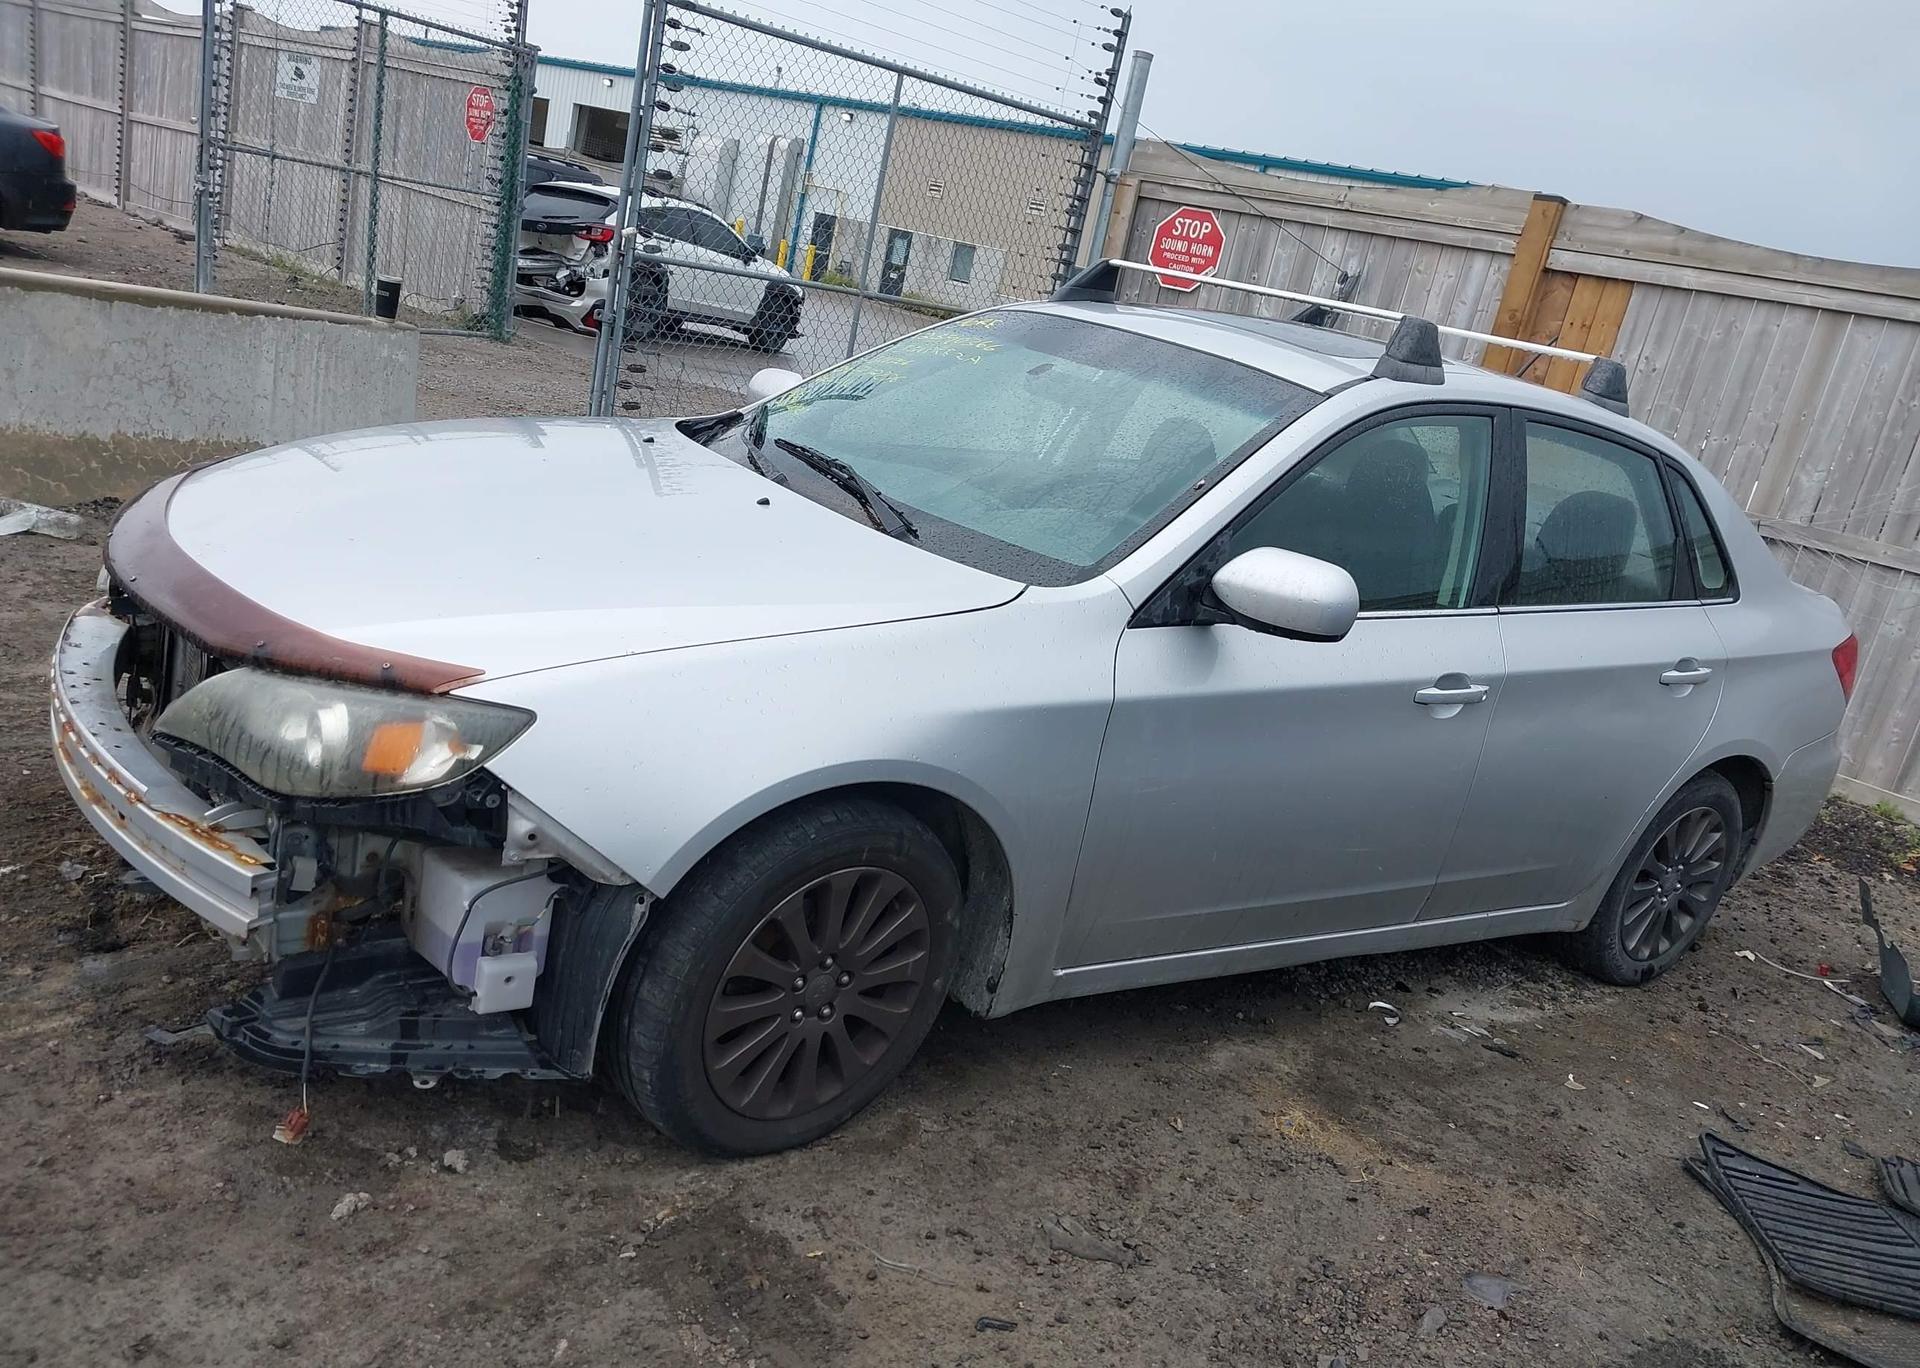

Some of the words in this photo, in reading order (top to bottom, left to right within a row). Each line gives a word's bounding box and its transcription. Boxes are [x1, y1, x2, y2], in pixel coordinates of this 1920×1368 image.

[472, 93, 490, 108] STOP
[1172, 218, 1212, 239] STOP
[1160, 237, 1188, 252] SOUND
[1190, 243, 1214, 257] HORN
[1162, 251, 1189, 262] PROCEED
[1190, 257, 1206, 265] WITH
[1168, 262, 1194, 272] CAUTION
